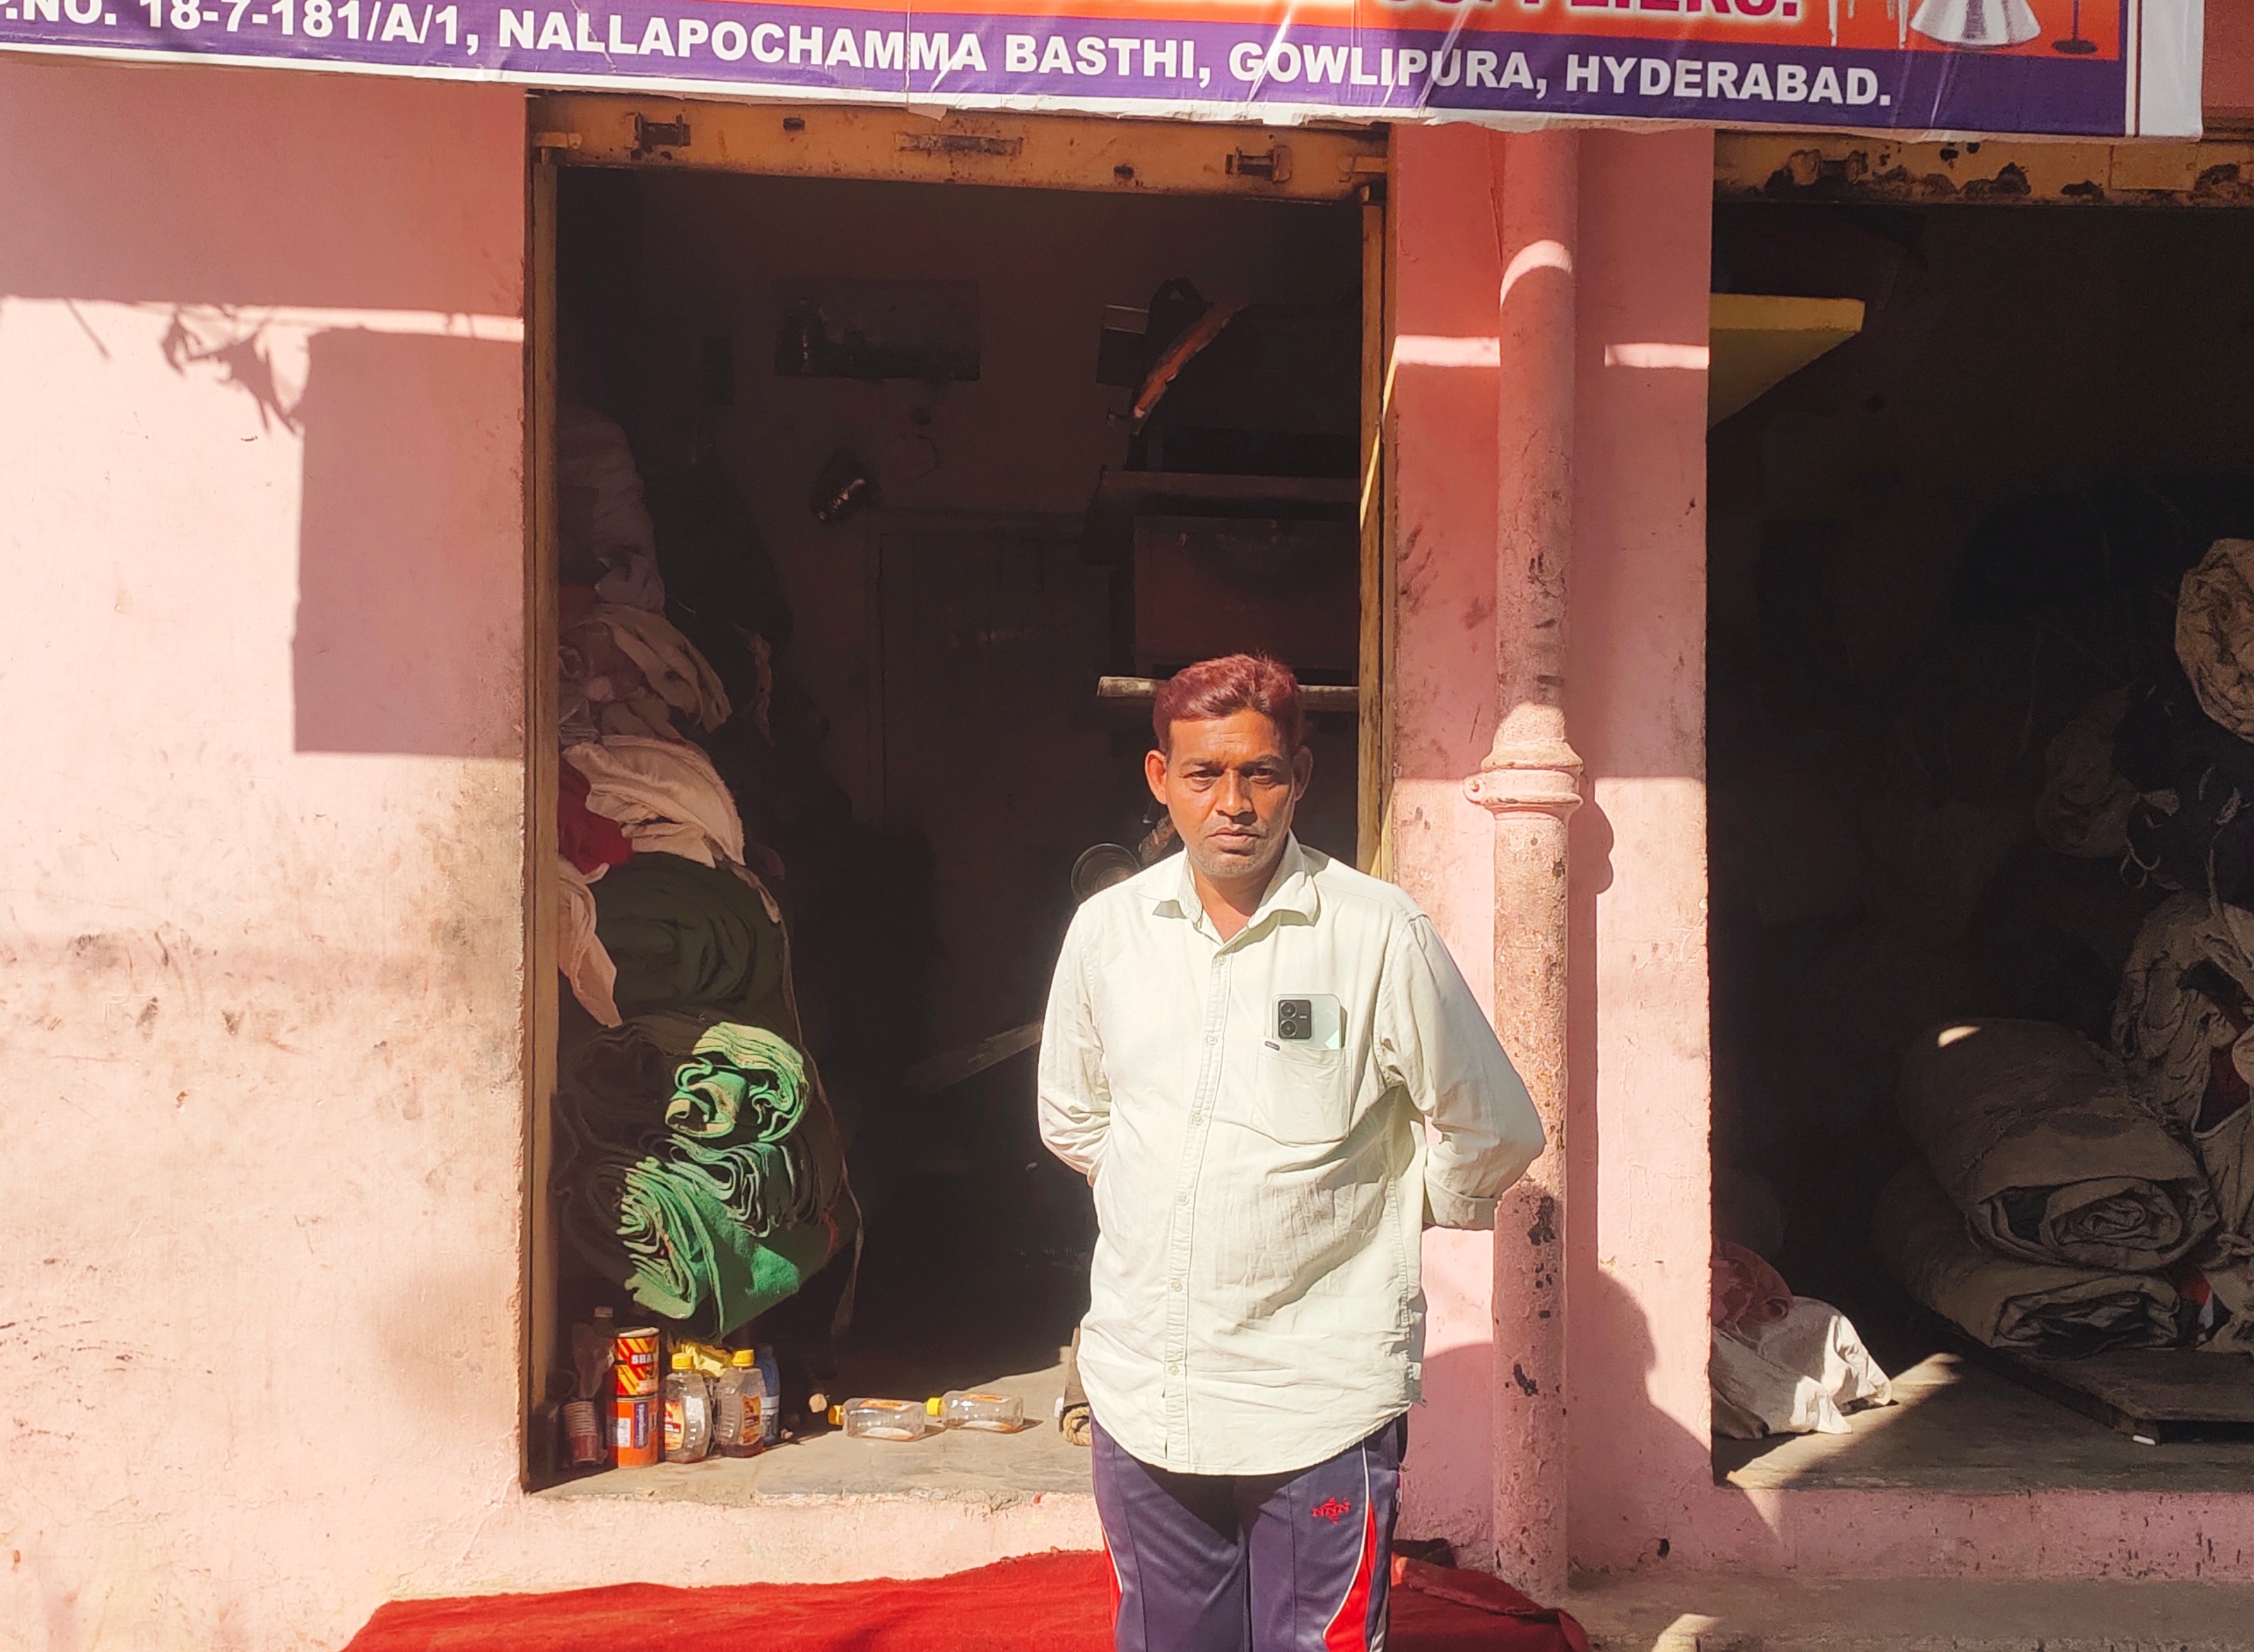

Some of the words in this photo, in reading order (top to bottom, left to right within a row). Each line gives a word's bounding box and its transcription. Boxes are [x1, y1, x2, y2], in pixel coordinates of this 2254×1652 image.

[0, 0, 117, 26] .NO.
[139, 0, 479, 57] 18-7-181/A/1,
[498, 9, 988, 72] NALLAPOCHAMMA
[1006, 35, 1211, 89] BASTHI,
[1228, 42, 1546, 100] GOWLIPURA,
[1566, 55, 1891, 106] HYDERABAD.
